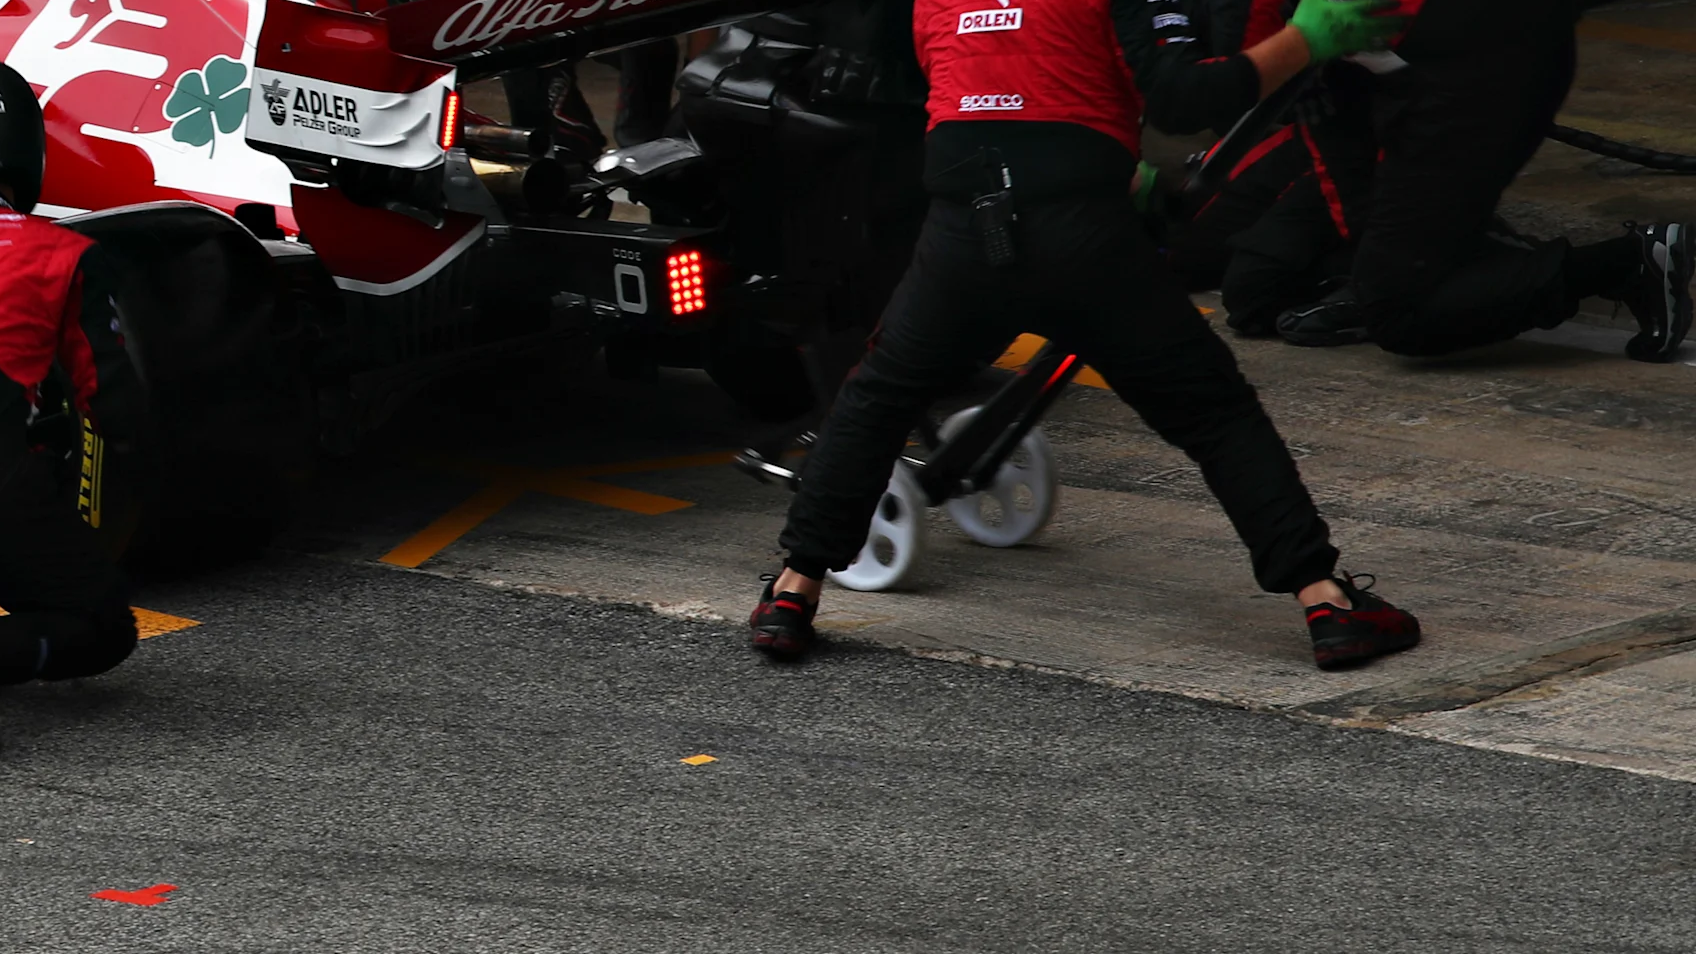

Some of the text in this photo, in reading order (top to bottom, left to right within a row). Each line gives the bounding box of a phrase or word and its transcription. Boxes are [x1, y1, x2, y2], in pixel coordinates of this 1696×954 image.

[961, 11, 1019, 32] ORLEN
[292, 87, 358, 123] ADLER
[957, 93, 1026, 113] sparco
[292, 113, 361, 138] PELZER GROUP
[612, 247, 642, 261] CODE
